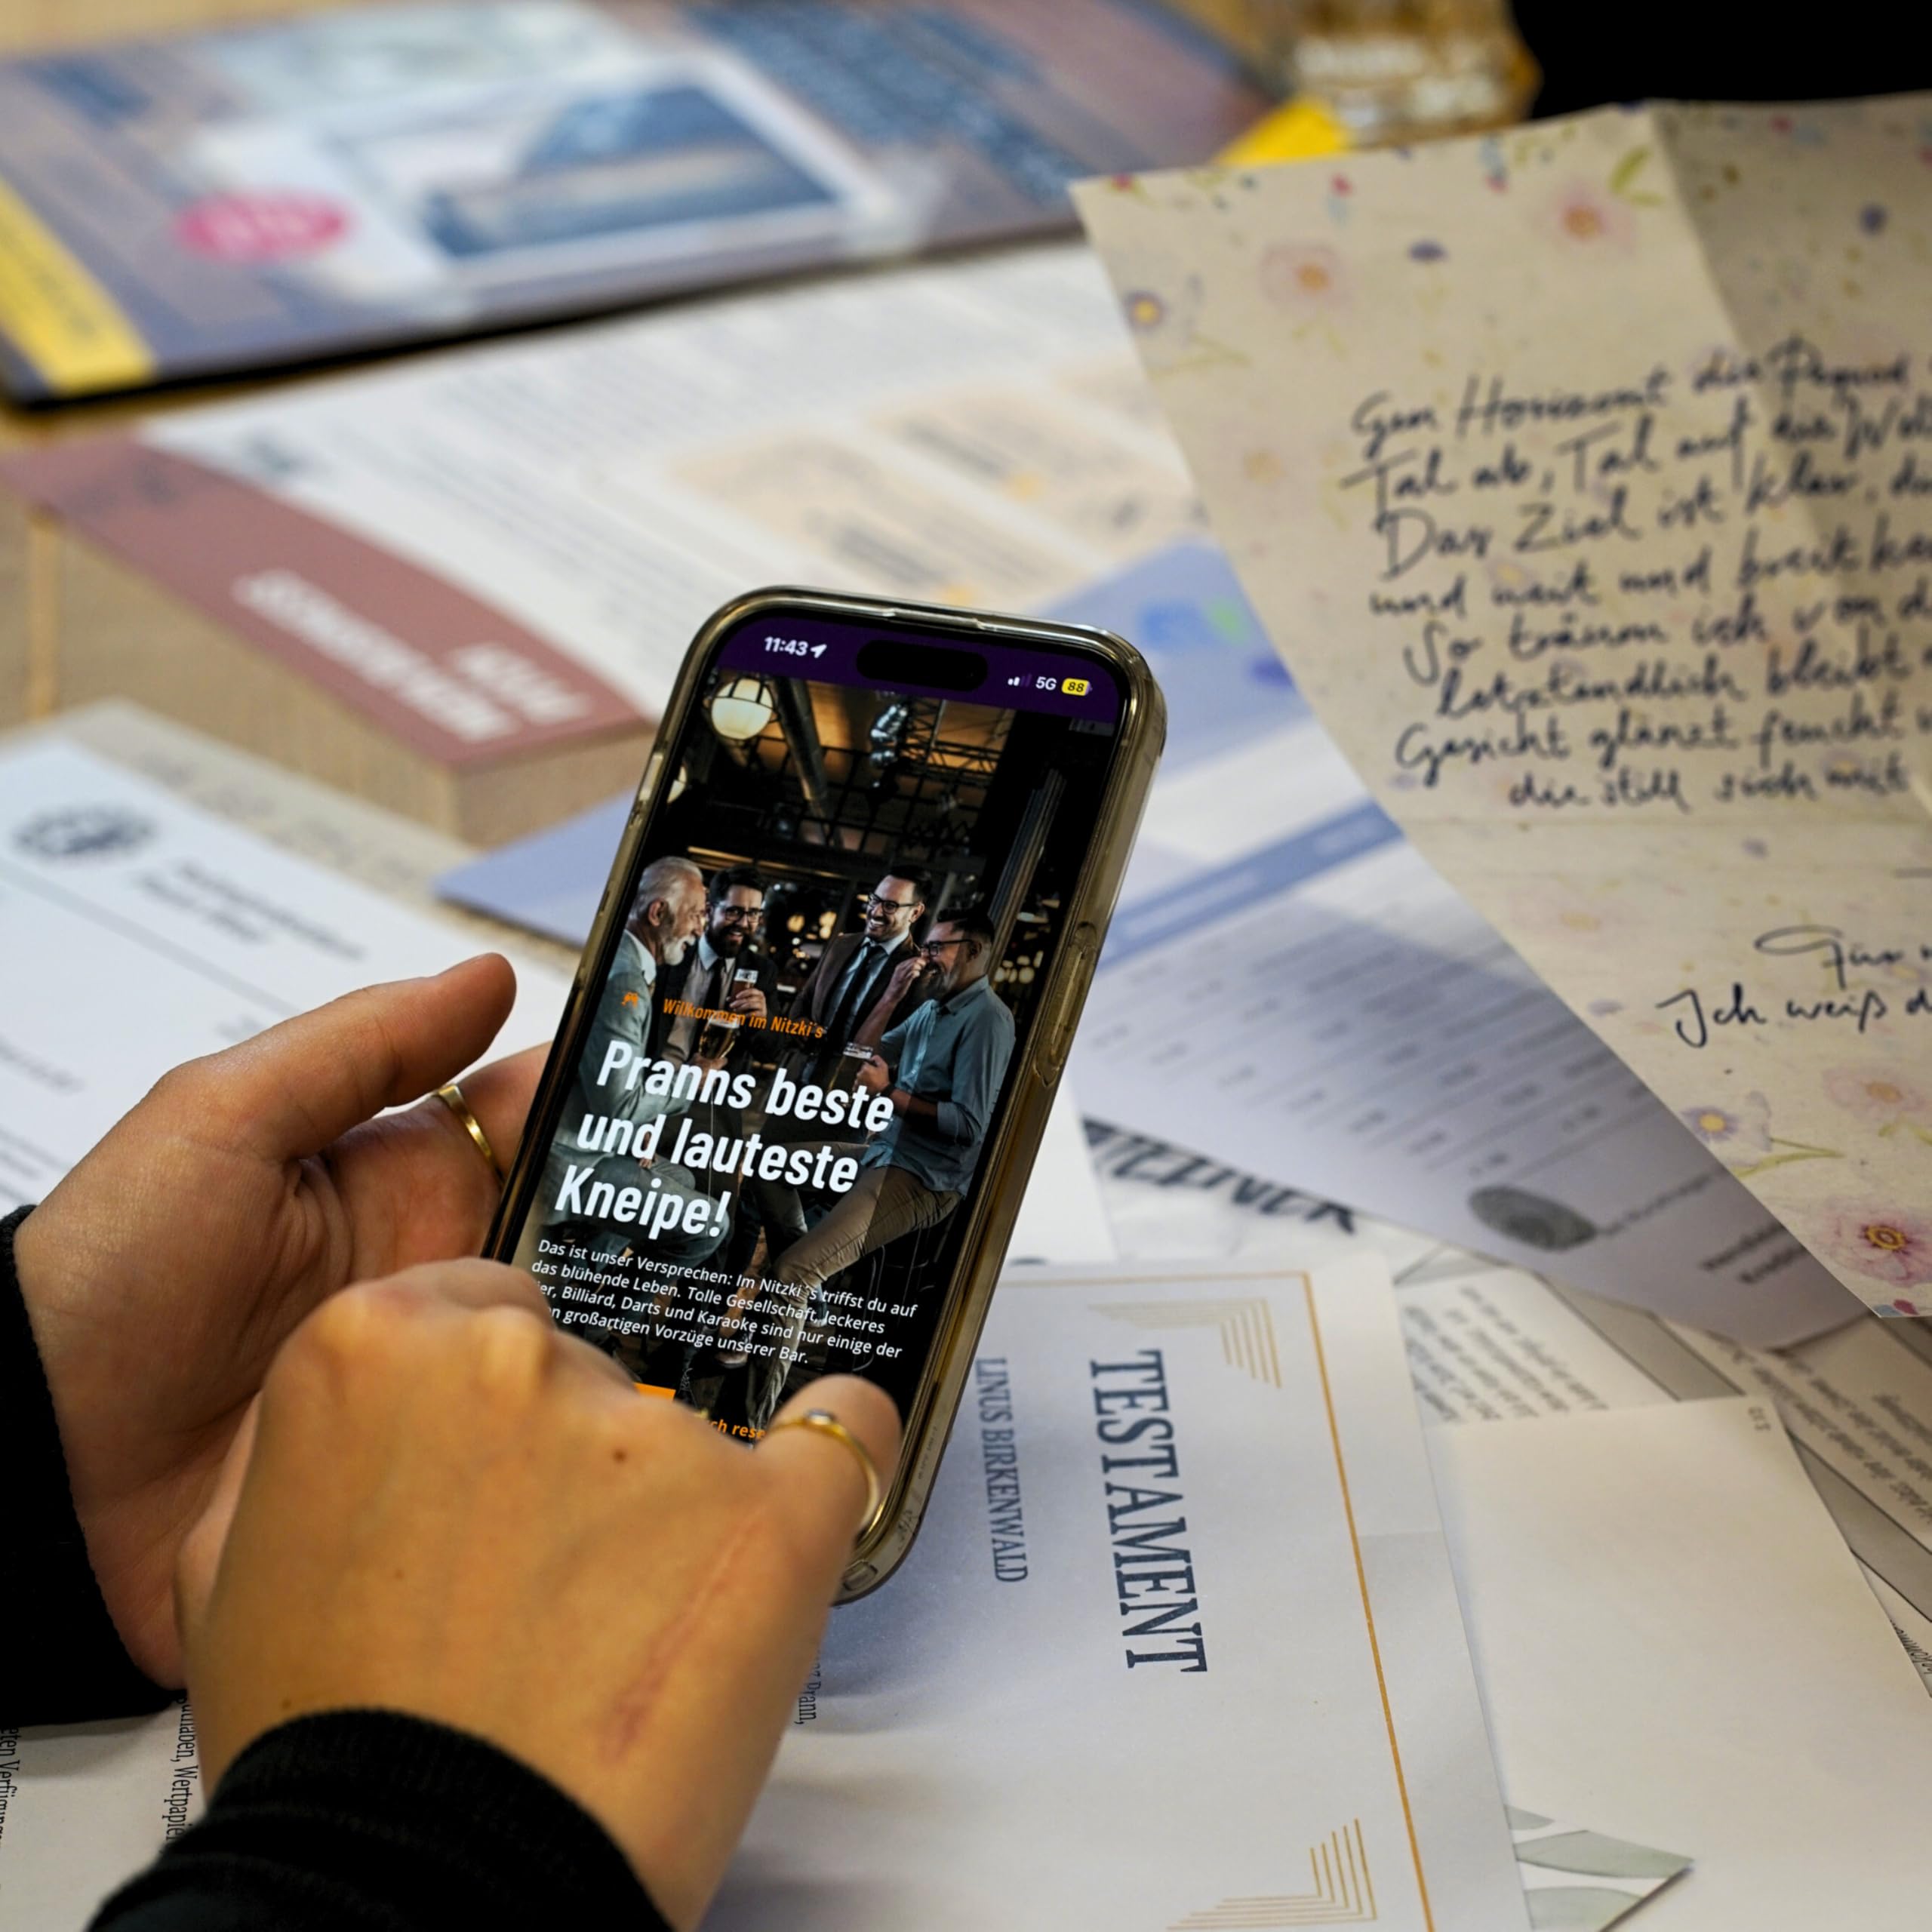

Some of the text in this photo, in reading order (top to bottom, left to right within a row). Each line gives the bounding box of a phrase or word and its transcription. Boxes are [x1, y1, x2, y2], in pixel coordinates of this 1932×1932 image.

[1515, 486, 1641, 552] Ziel
[1658, 477, 1724, 525] ist
[1370, 574, 1466, 619] und
[1620, 544, 1712, 594] und
[764, 636, 808, 657] 11:43
[1403, 620, 1482, 688] So
[1035, 676, 1085, 693] 5G 88
[663, 998, 746, 1026] Willkommen
[749, 1013, 767, 1029] im
[1786, 989, 1887, 1033] weiß
[596, 1039, 894, 1133] Pranns beste
[577, 1112, 859, 1194] und lauteste
[555, 1164, 731, 1240] Kneipe!
[531, 1260, 885, 1334] das blühende Leben. Tolle Gesellschaft, leckeres
[537, 1239, 566, 1256] Das
[568, 1244, 591, 1260] ist
[591, 1251, 633, 1267] unser
[637, 1256, 733, 1285] Versprechen:
[736, 1274, 755, 1288] Im
[822, 1291, 864, 1309] triffst
[867, 1297, 885, 1312] du
[891, 1304, 918, 1318] auf
[561, 1286, 617, 1309] Billiard,
[621, 1297, 661, 1315] Darts
[665, 1308, 694, 1322] und
[697, 1311, 758, 1333] Karaoke
[761, 1321, 794, 1340] sind
[796, 1331, 823, 1345] nur
[827, 1335, 872, 1355] einige
[875, 1343, 903, 1358] der
[562, 1309, 650, 1335] großartigen
[654, 1323, 714, 1348] Vorzüge
[717, 1338, 776, 1357] unserer
[779, 1346, 808, 1364] Bar.
[974, 1356, 1029, 1583] LINUS BIRKENWALD
[1089, 1349, 1208, 1673] TESTAMENT
